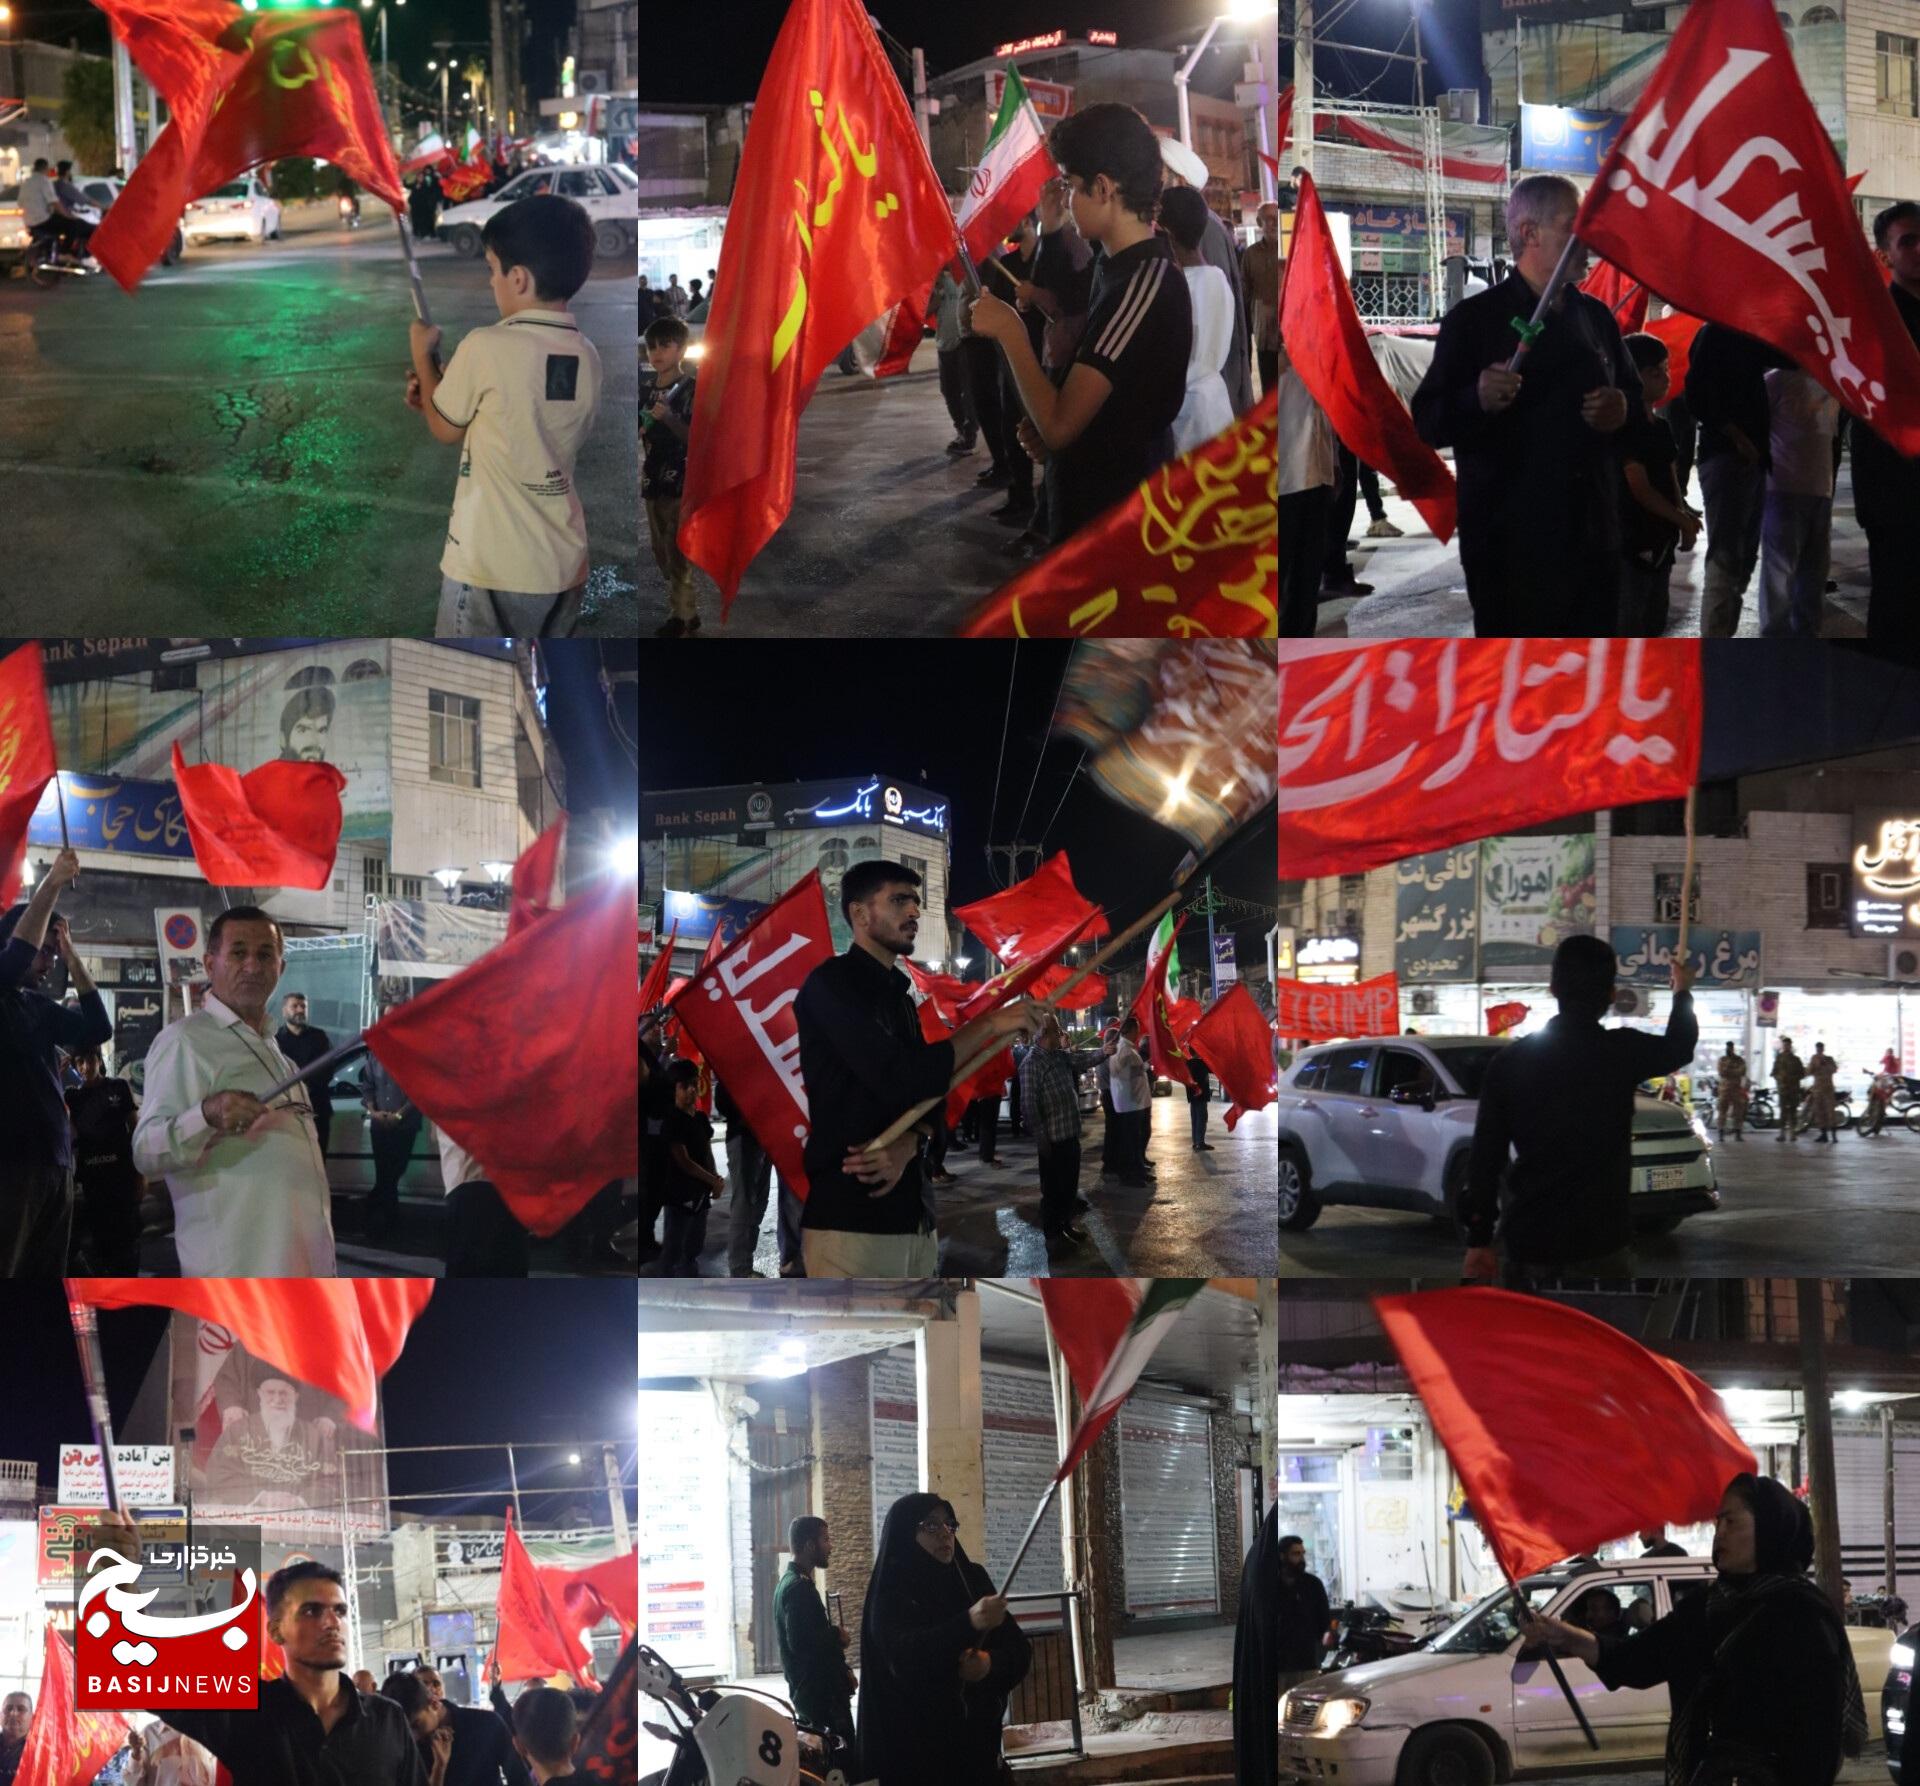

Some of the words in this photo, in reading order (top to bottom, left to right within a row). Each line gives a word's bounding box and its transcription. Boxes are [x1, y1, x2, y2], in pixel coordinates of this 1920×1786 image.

[655, 811, 689, 826] Bank
[694, 809, 737, 826] Sepah
[815, 782, 880, 818] بانک
[1711, 932, 1759, 980] مرغ
[118, 1446, 148, 1462] آماده
[758, 1729, 782, 1768] 8
